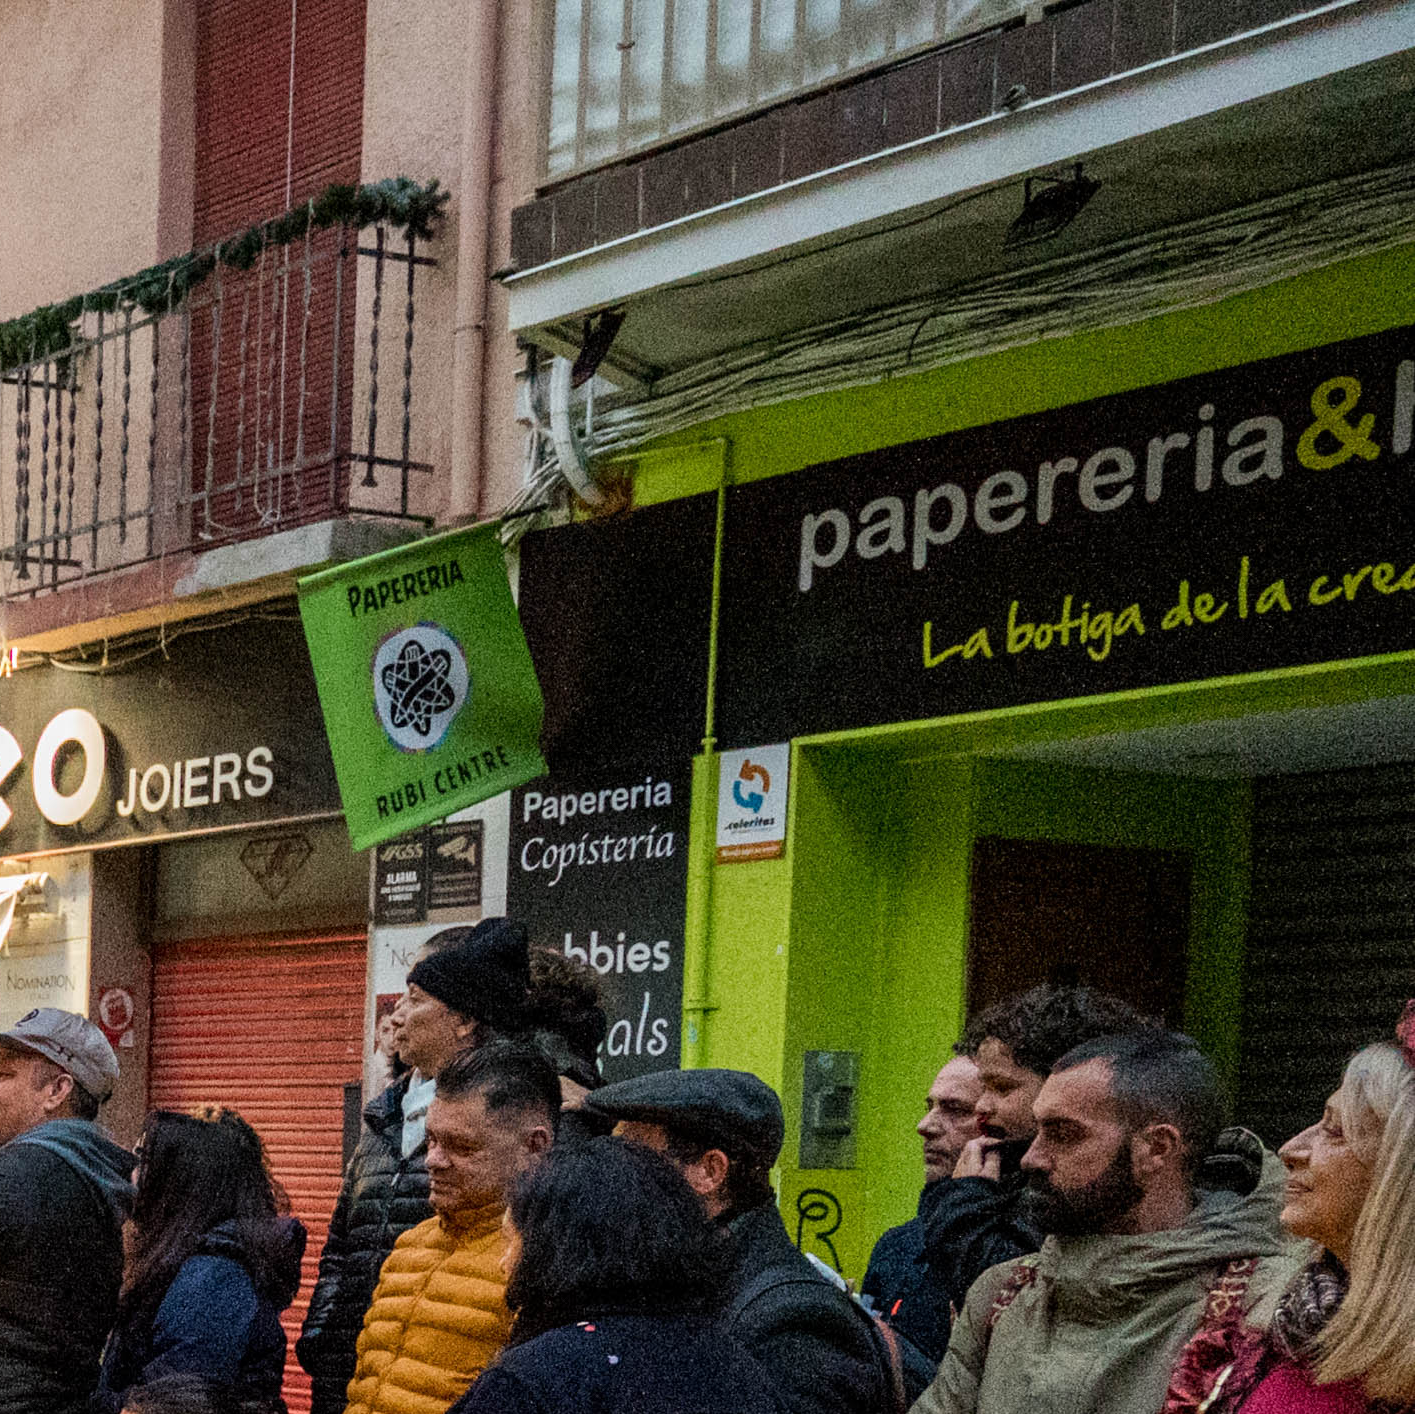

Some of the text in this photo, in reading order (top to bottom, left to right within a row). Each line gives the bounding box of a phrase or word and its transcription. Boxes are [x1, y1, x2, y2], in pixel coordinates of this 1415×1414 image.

[347, 559, 465, 617] PAPERERIA
[922, 621, 992, 668] La
[1005, 595, 1148, 662] botiga
[1160, 580, 1229, 631] de
[1235, 556, 1293, 618] la
[116, 746, 274, 818] JOIERS
[376, 746, 510, 819] RUBI CENTRE
[523, 776, 672, 825] Papereria
[7, 972, 76, 992] NOMINATION
[564, 931, 670, 975] bbies
